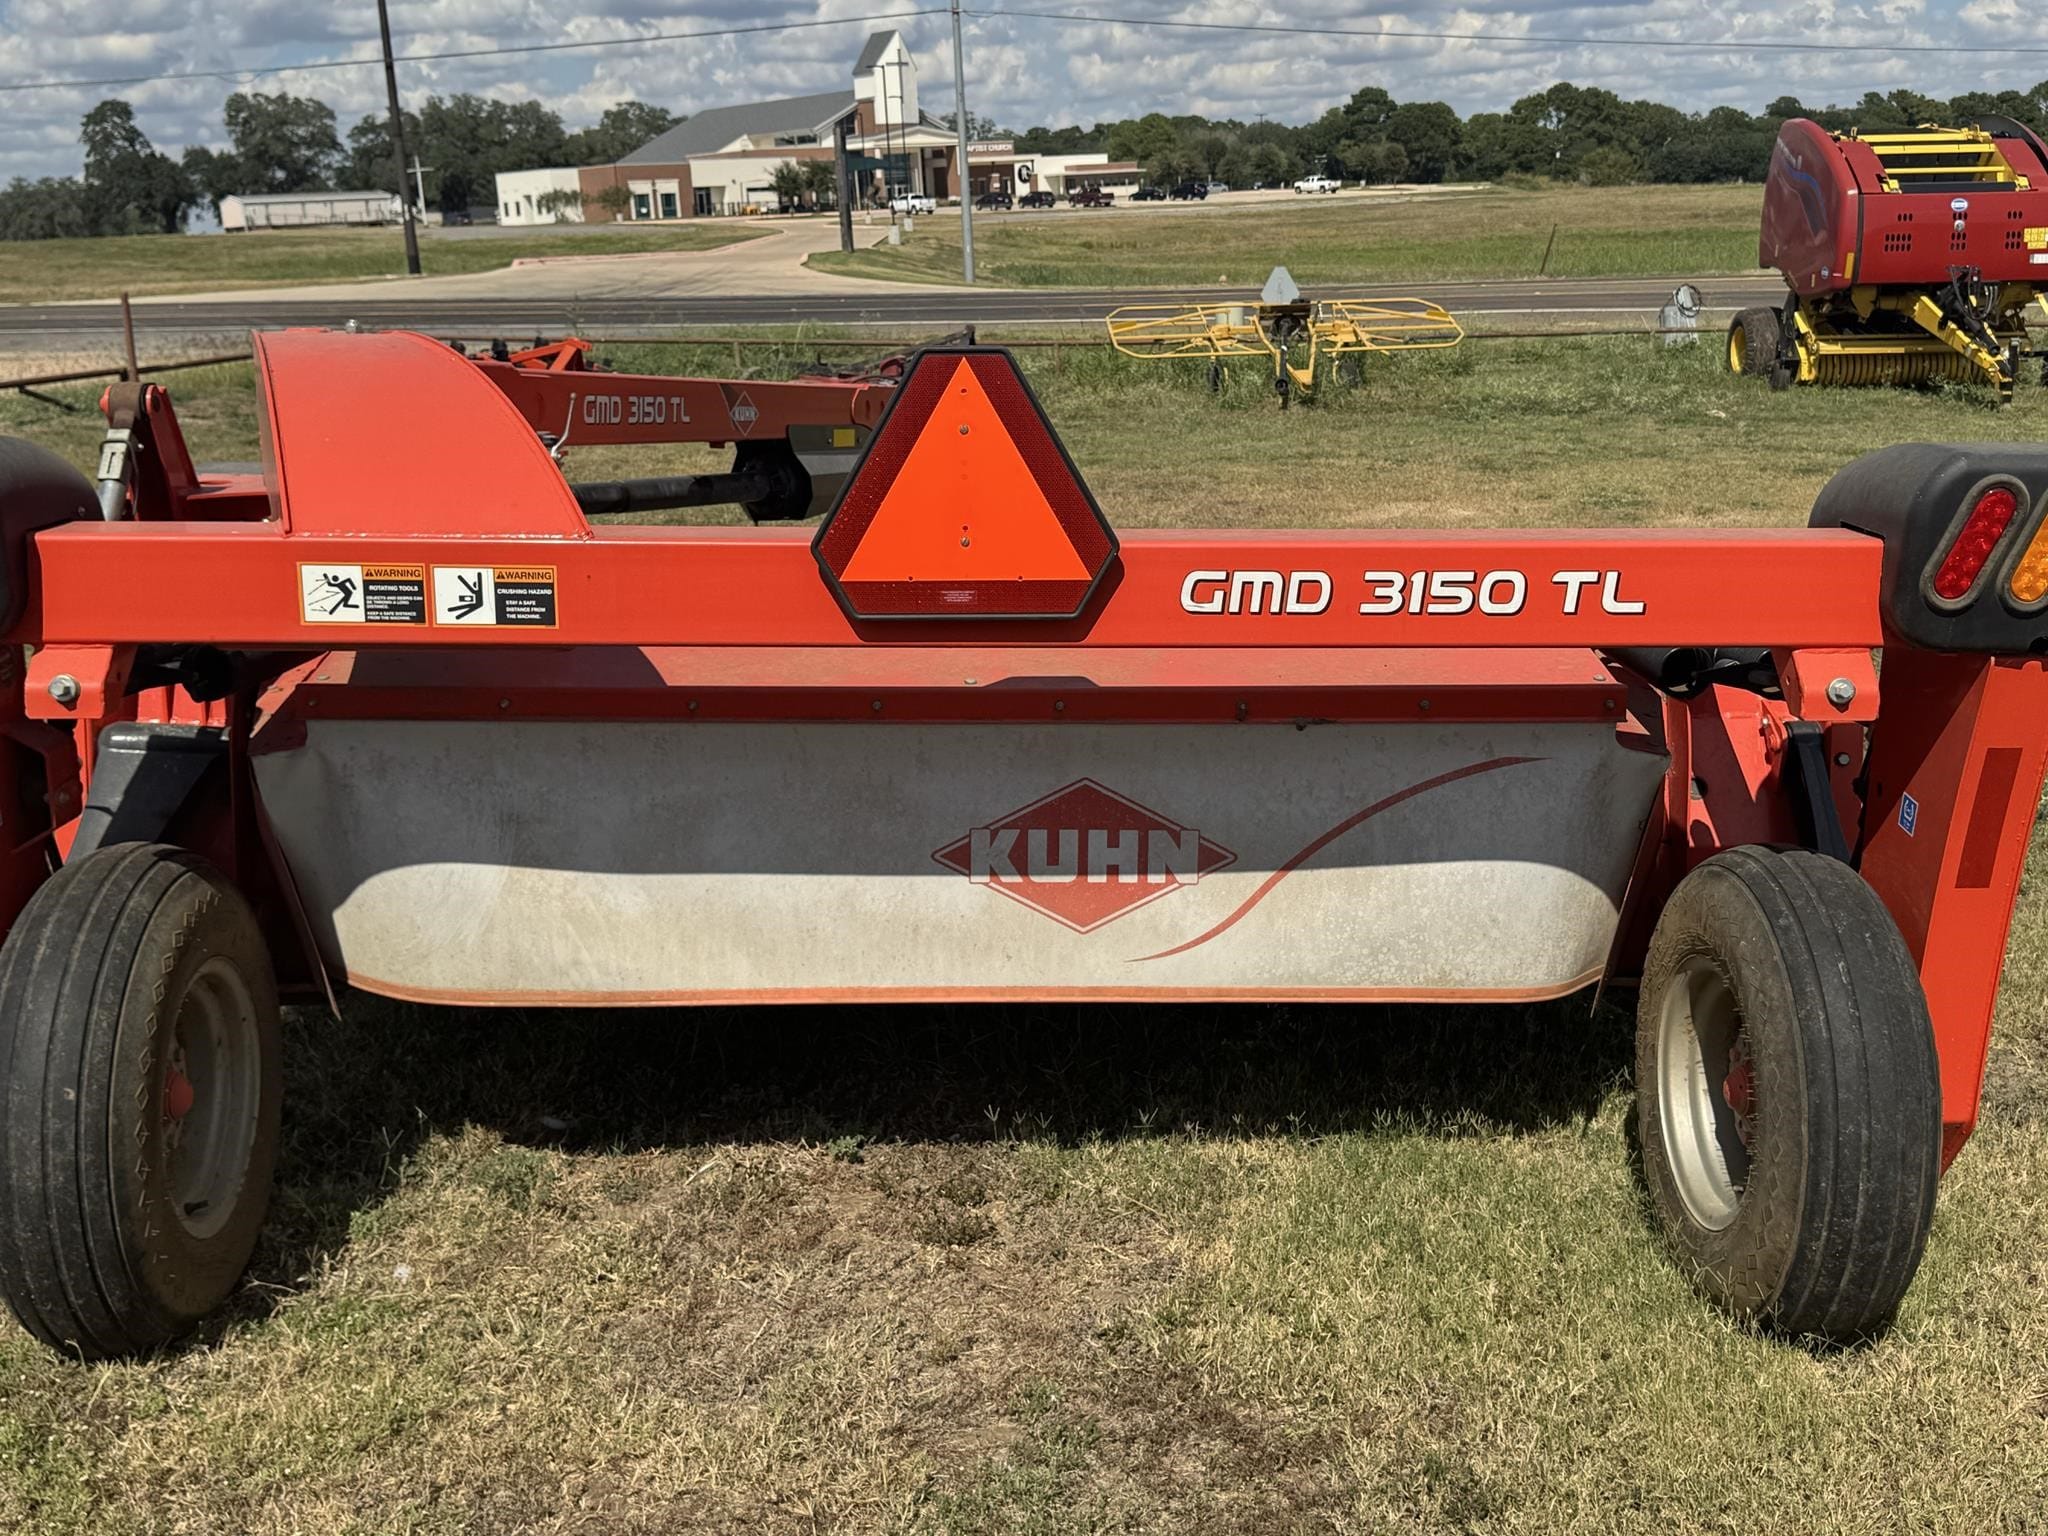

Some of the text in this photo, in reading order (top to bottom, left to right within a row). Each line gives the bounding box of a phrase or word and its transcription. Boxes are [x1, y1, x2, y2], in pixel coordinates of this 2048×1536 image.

[584, 395, 691, 424] GMD 3150 TL
[374, 569, 421, 578] WARNING
[505, 571, 552, 580] WARNING
[1180, 570, 1647, 615] GMD 3150 TL
[970, 828, 1199, 884] KUHN
